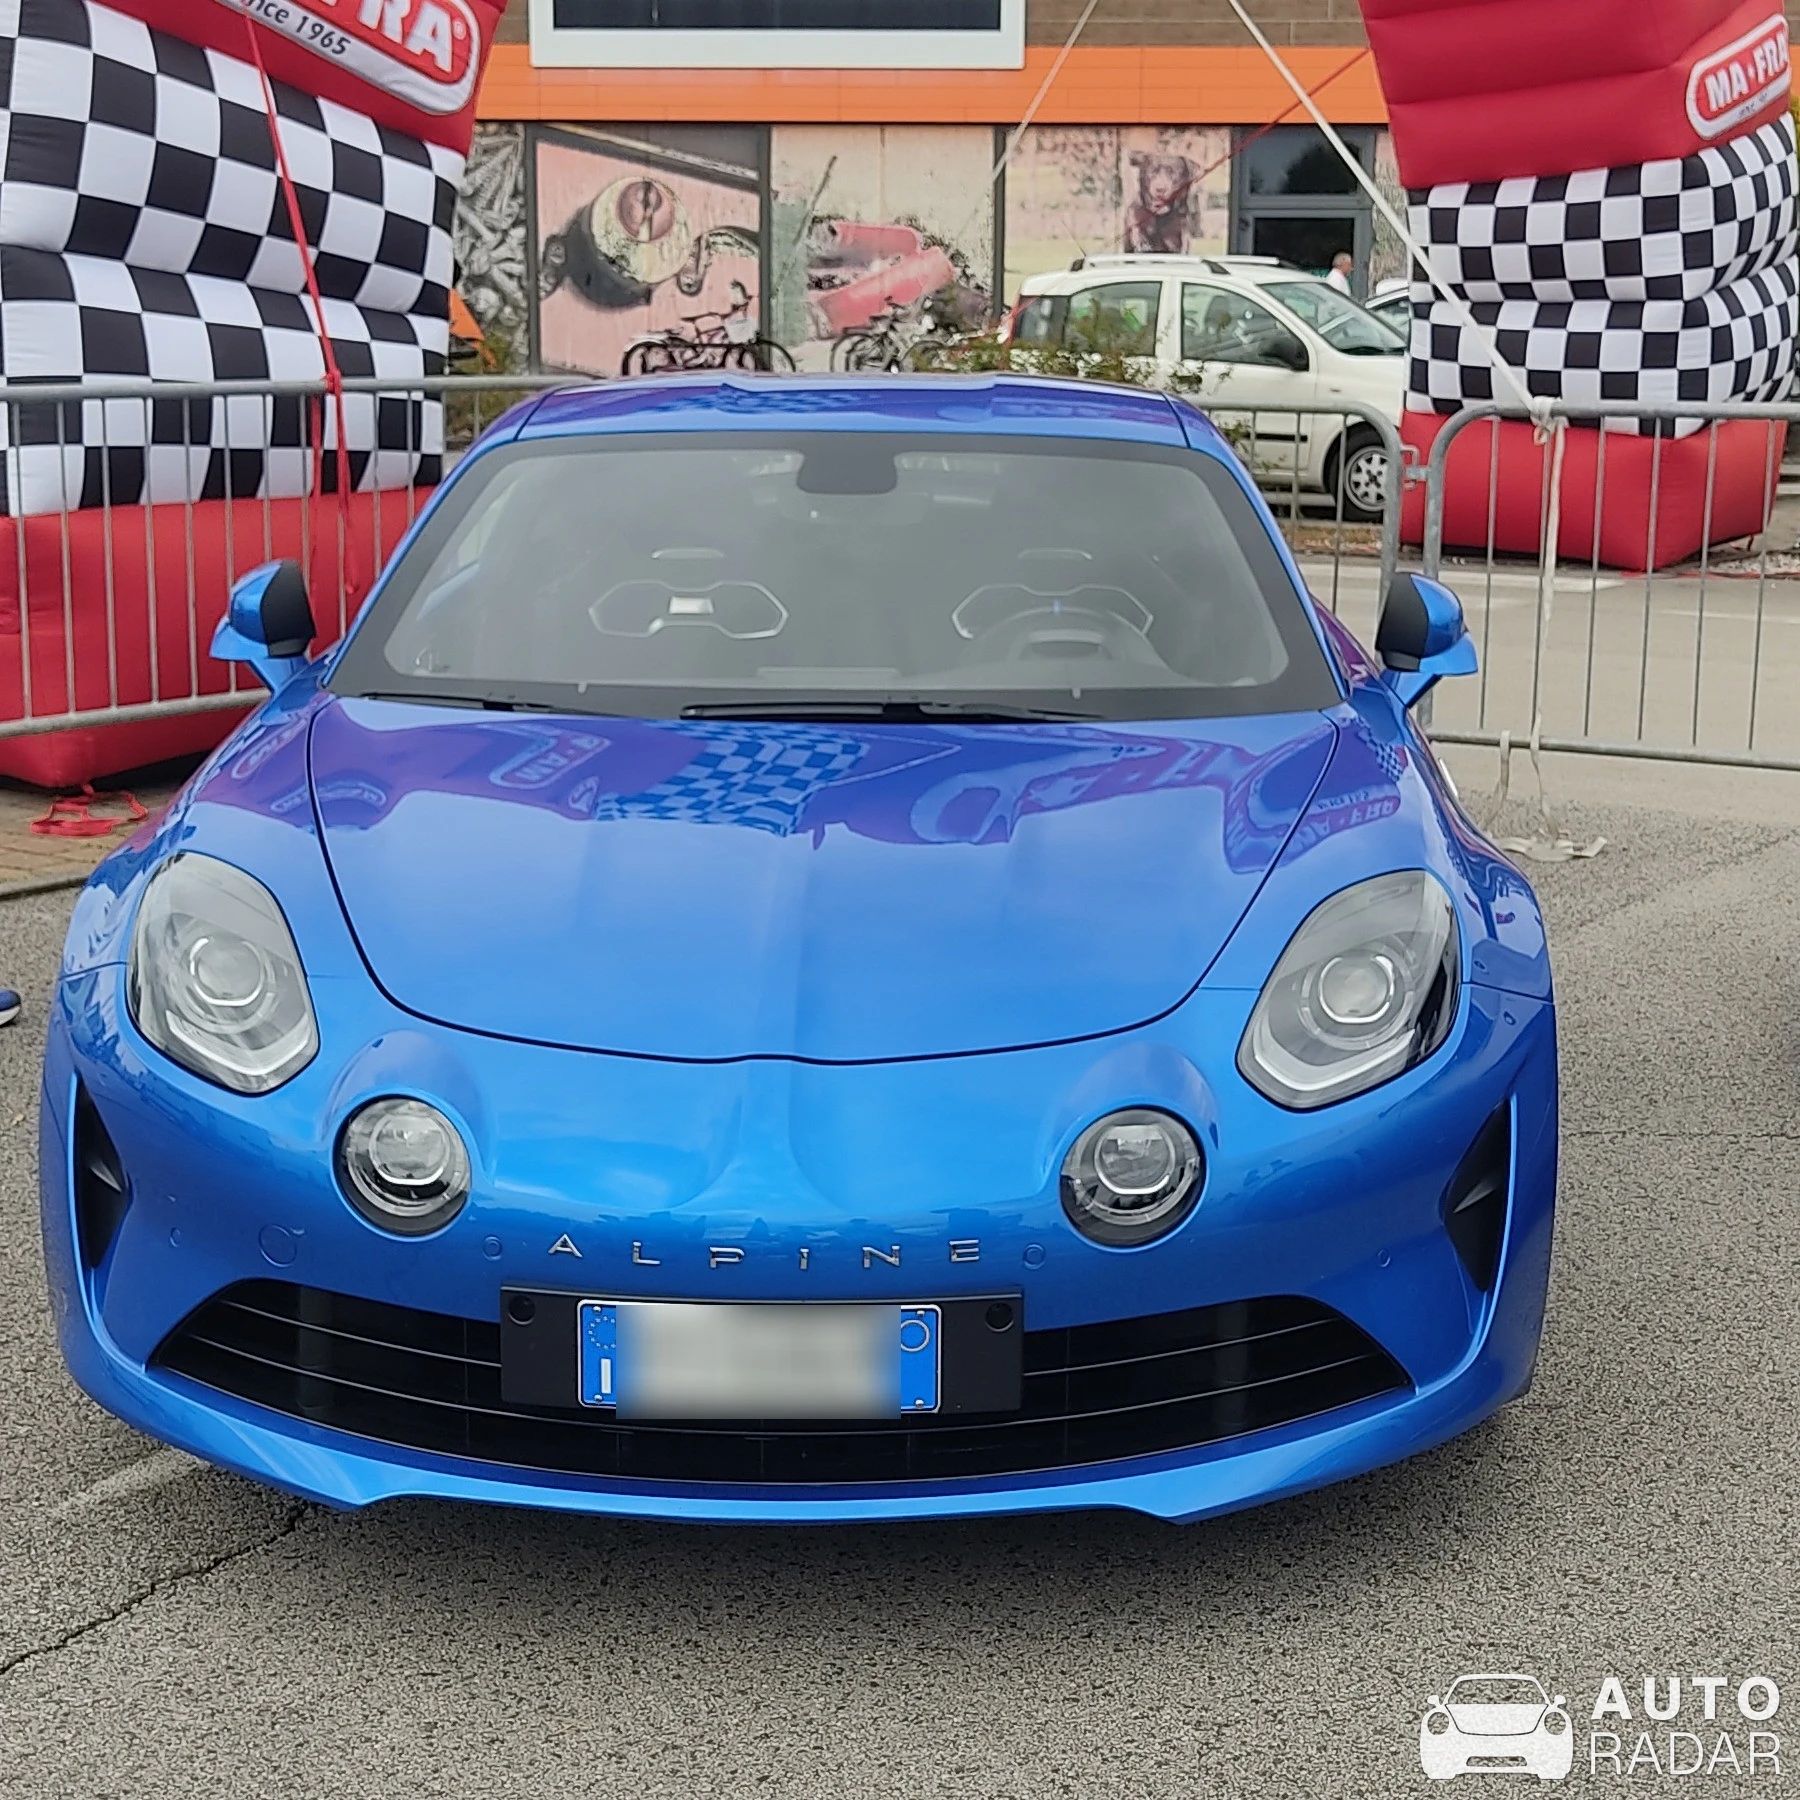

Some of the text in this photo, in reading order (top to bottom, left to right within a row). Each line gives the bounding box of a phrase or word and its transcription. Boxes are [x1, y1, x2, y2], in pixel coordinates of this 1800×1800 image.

[296, 15, 351, 55] 1965
[321, 0, 453, 73] RA
[547, 1232, 981, 1270] ALPINE
